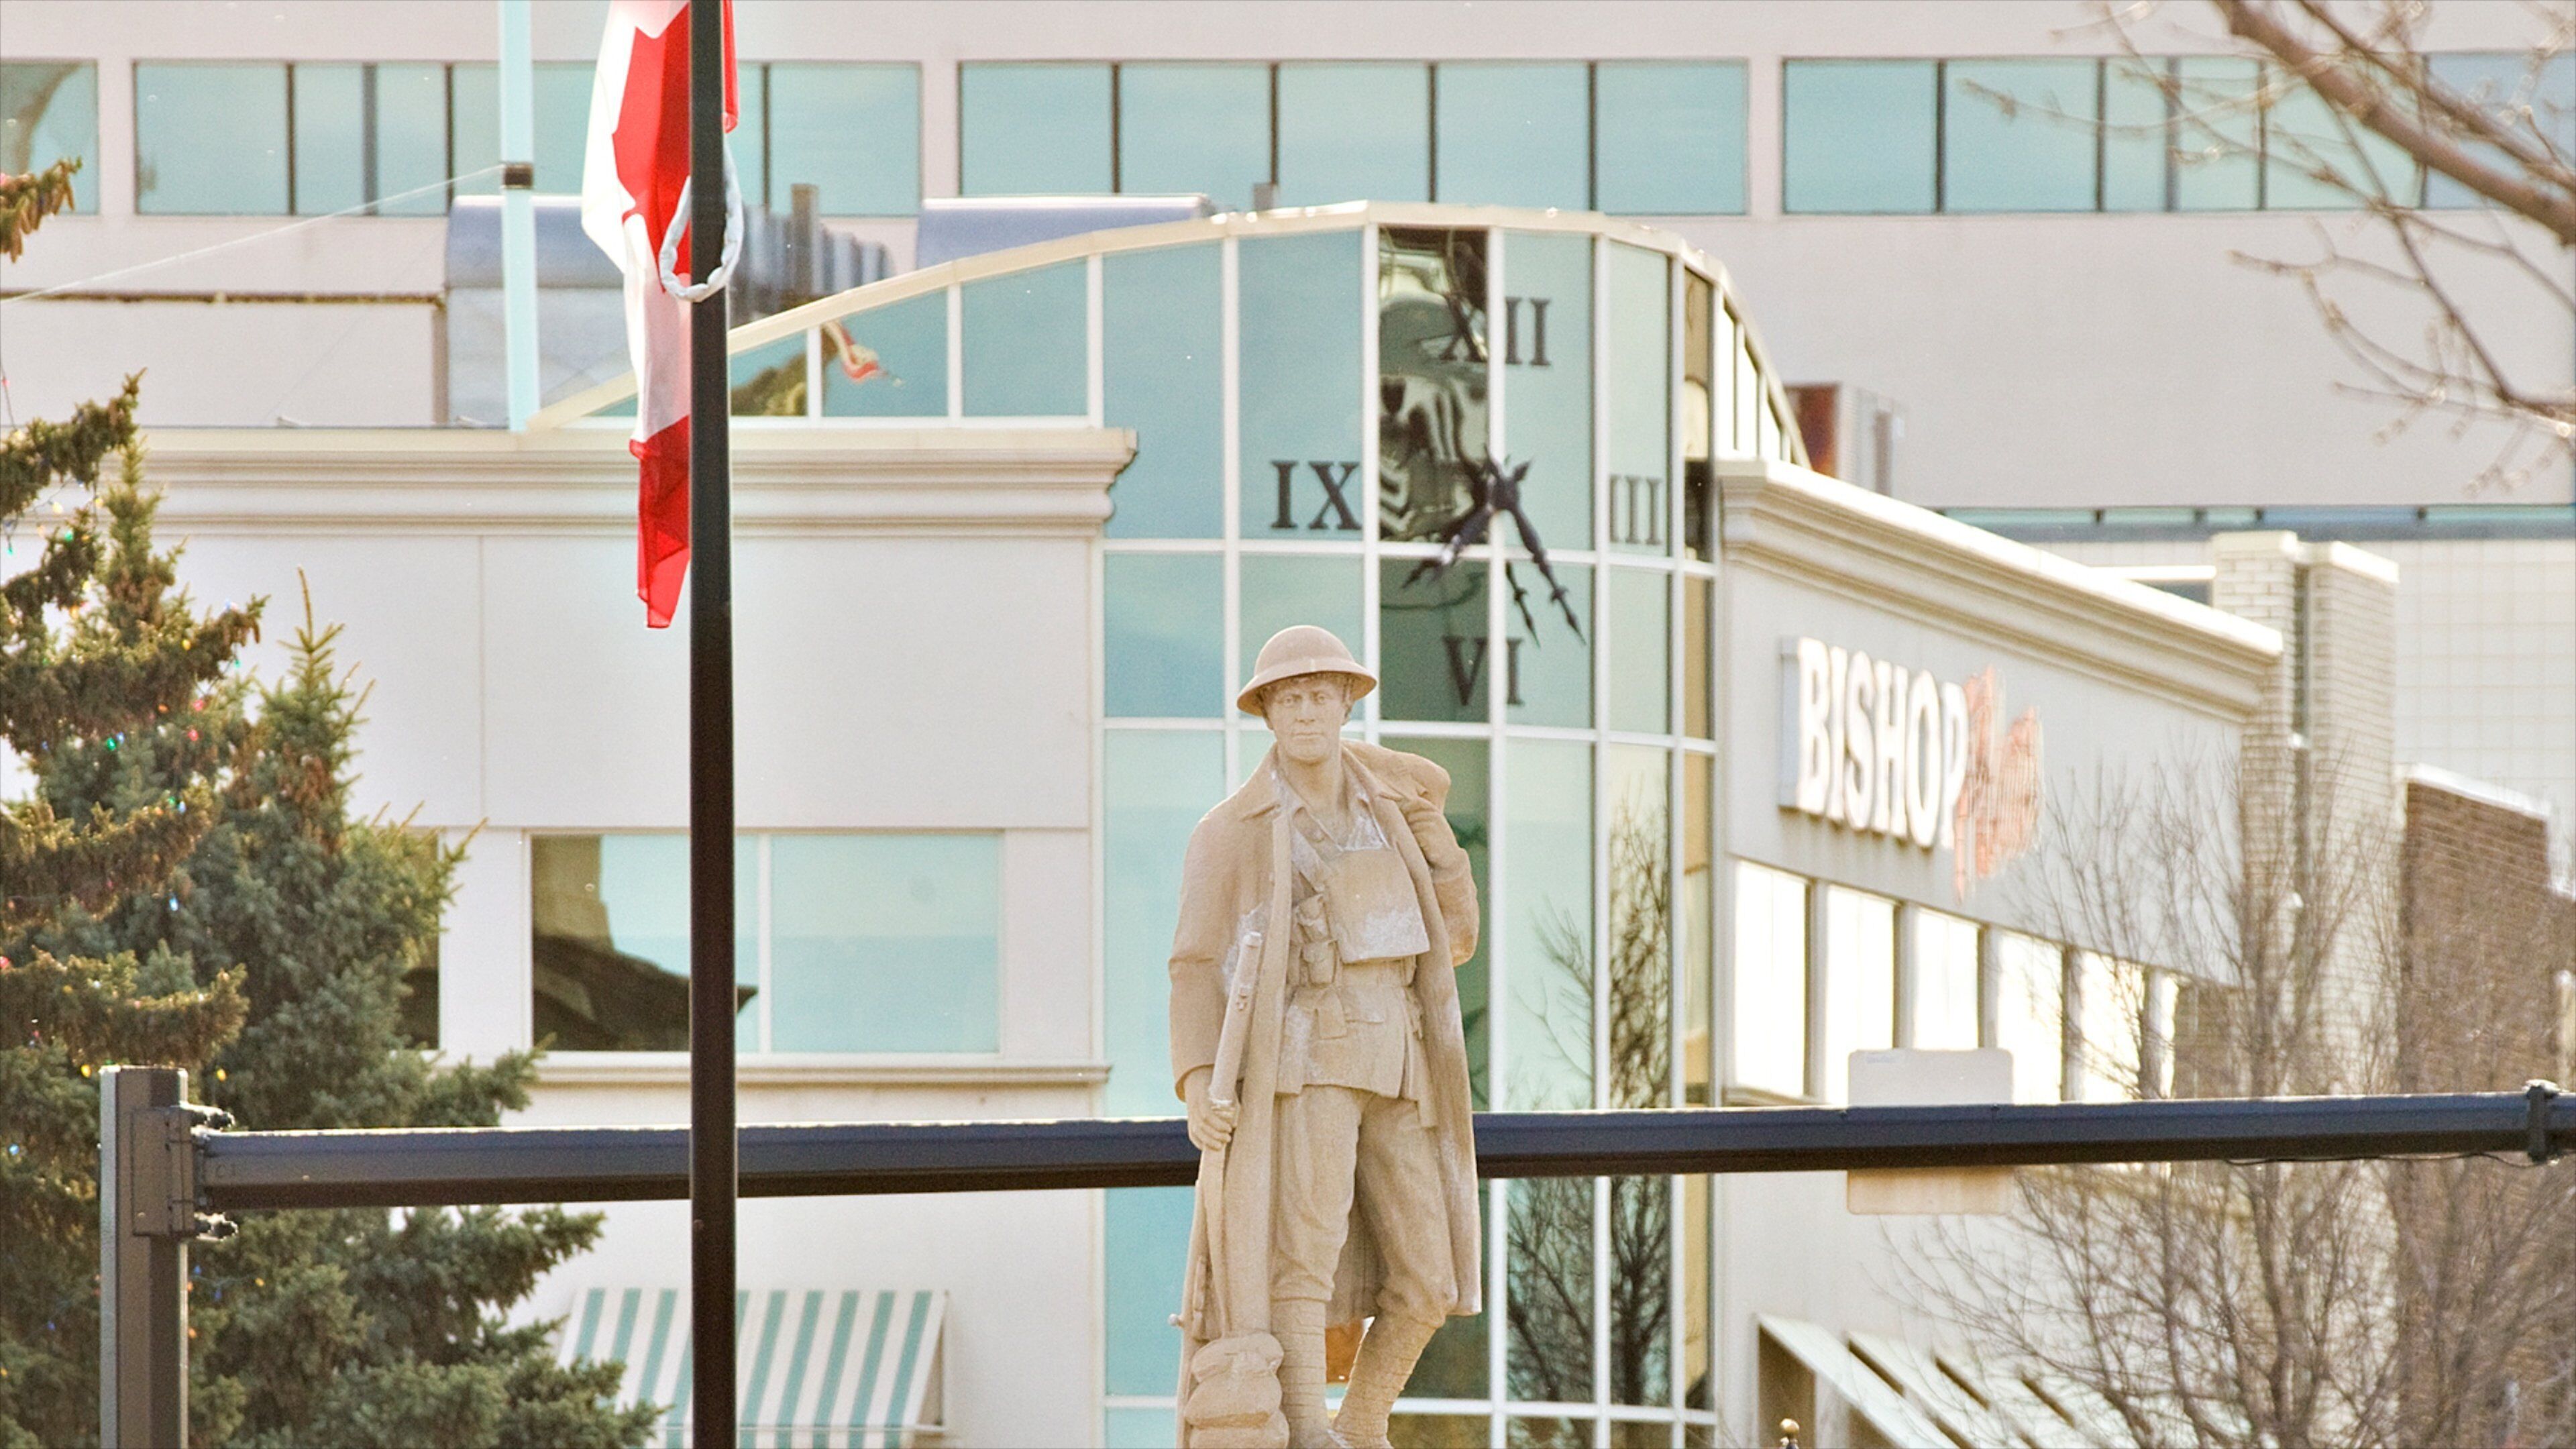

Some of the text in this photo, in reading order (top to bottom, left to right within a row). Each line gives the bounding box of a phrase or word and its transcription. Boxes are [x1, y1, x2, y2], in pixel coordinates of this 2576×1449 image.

[1439, 296, 1552, 366] XII
[1270, 460, 1362, 530] IX
[1608, 474, 1664, 546] III
[1442, 635, 1524, 706] VI
[1798, 637, 1970, 851] BISHOP
